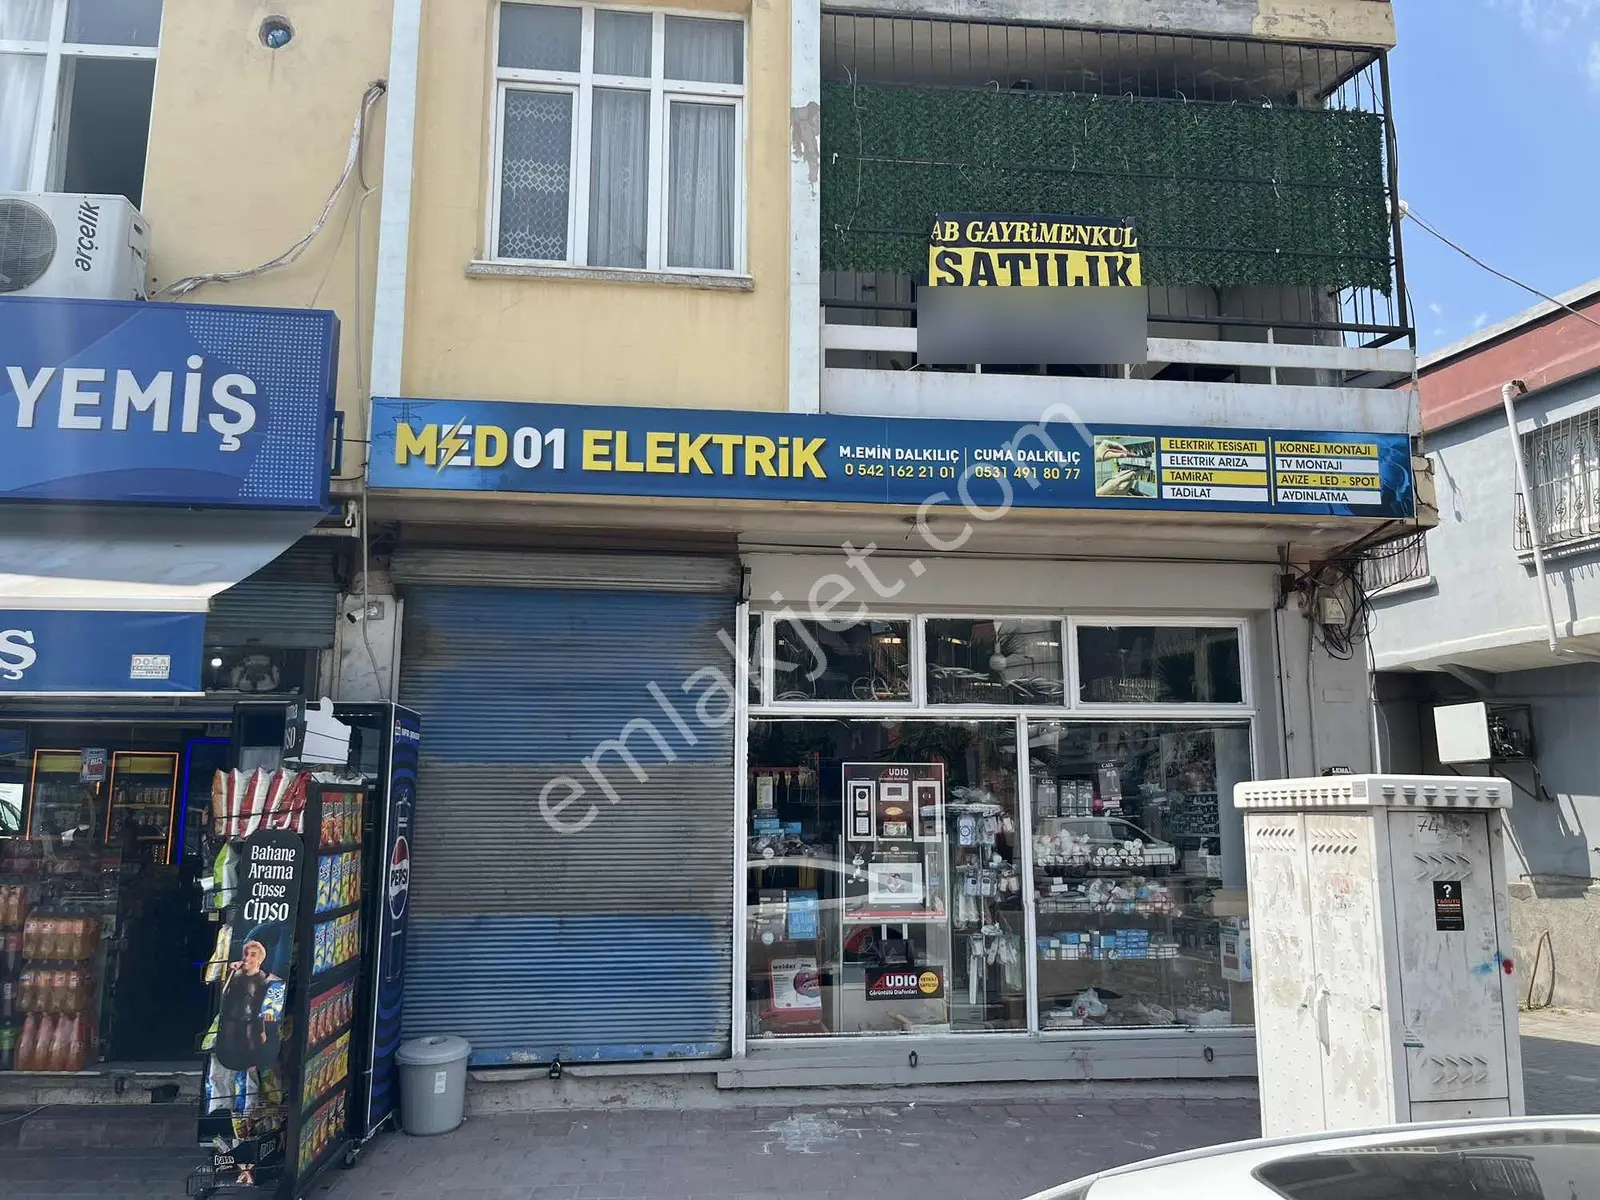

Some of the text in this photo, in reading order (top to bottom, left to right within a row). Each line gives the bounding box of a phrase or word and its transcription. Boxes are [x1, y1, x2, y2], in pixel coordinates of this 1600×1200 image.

[75, 201, 100, 272] arçelik
[931, 220, 960, 242] AB
[935, 249, 1133, 286] SATILIK
[6, 354, 257, 452] YEMİŞ
[839, 444, 960, 464] M.EMİN DALKILIÇ
[974, 448, 1081, 465] CUMA DALKILIÇ
[1280, 443, 1371, 455] KORNEJ MONTAJI
[1218, 457, 1249, 467] ARIZA
[1280, 459, 1342, 470] TV MONTAJI
[844, 463, 956, 479] 0 542 162 21 01
[975, 466, 1081, 480] 0531 491 80 77
[1320, 476, 1339, 486] LED
[1349, 477, 1375, 487] SPOT
[1282, 491, 1348, 502] AYDINLATMA
[251, 845, 296, 862] Bahane
[248, 862, 294, 880] Arama
[252, 881, 286, 899] Cipsse
[244, 898, 290, 924] Cipso
